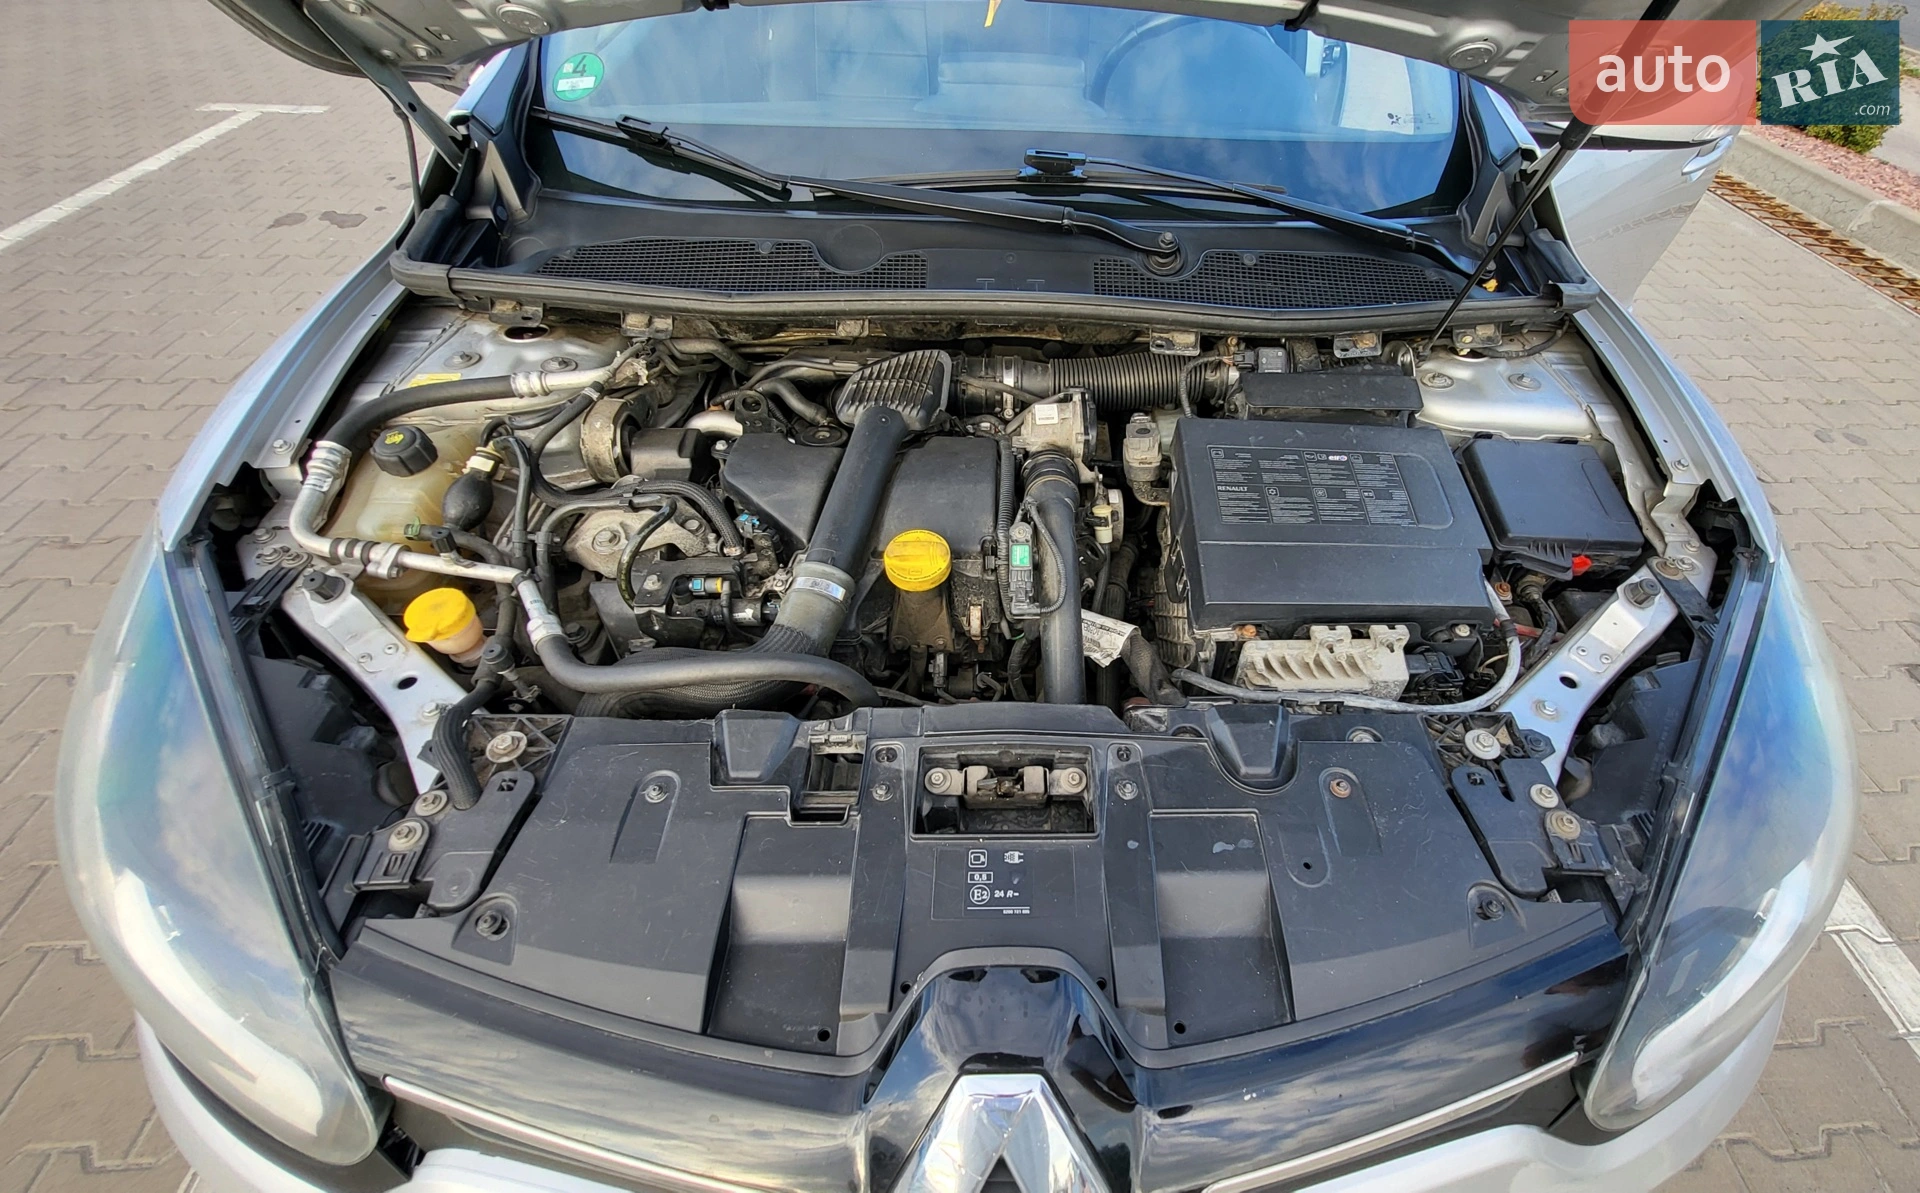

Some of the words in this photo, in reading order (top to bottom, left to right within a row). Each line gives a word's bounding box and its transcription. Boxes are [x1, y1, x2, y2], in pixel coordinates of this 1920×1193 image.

[572, 55, 587, 77] 4
[973, 889, 988, 901] E2
[994, 890, 1005, 898] 24
